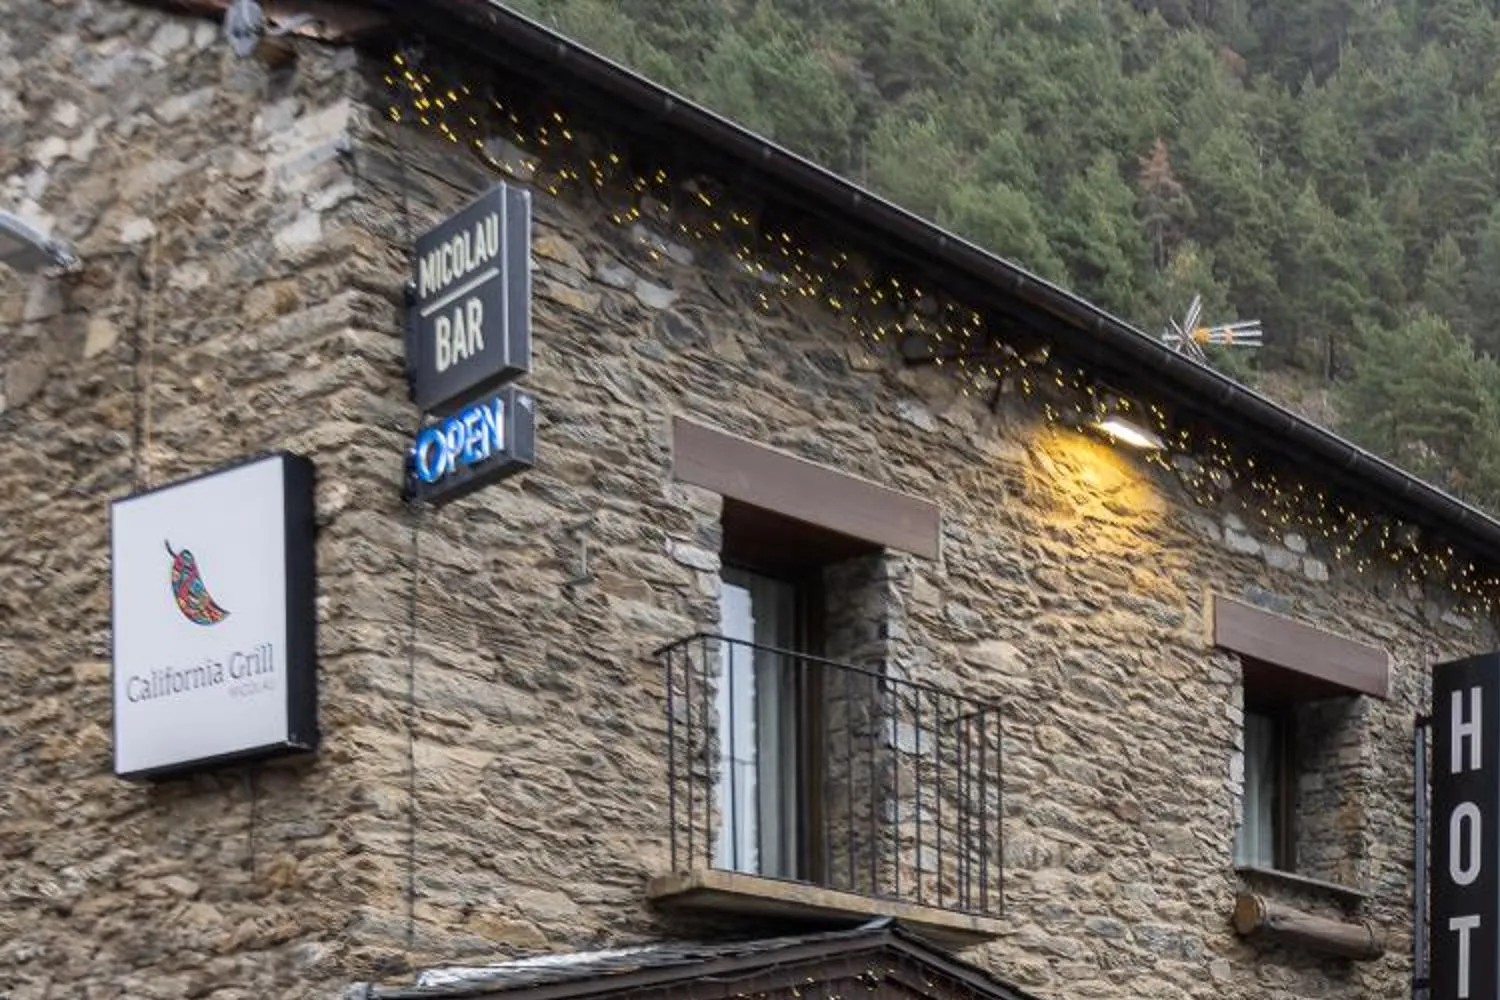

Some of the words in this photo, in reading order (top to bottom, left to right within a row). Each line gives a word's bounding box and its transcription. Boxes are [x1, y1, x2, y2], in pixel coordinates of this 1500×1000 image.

[419, 211, 500, 299] MICOLAU
[434, 296, 485, 374] BAR
[415, 396, 506, 484] OPEN
[127, 659, 225, 703] California
[229, 642, 274, 680] Grill
